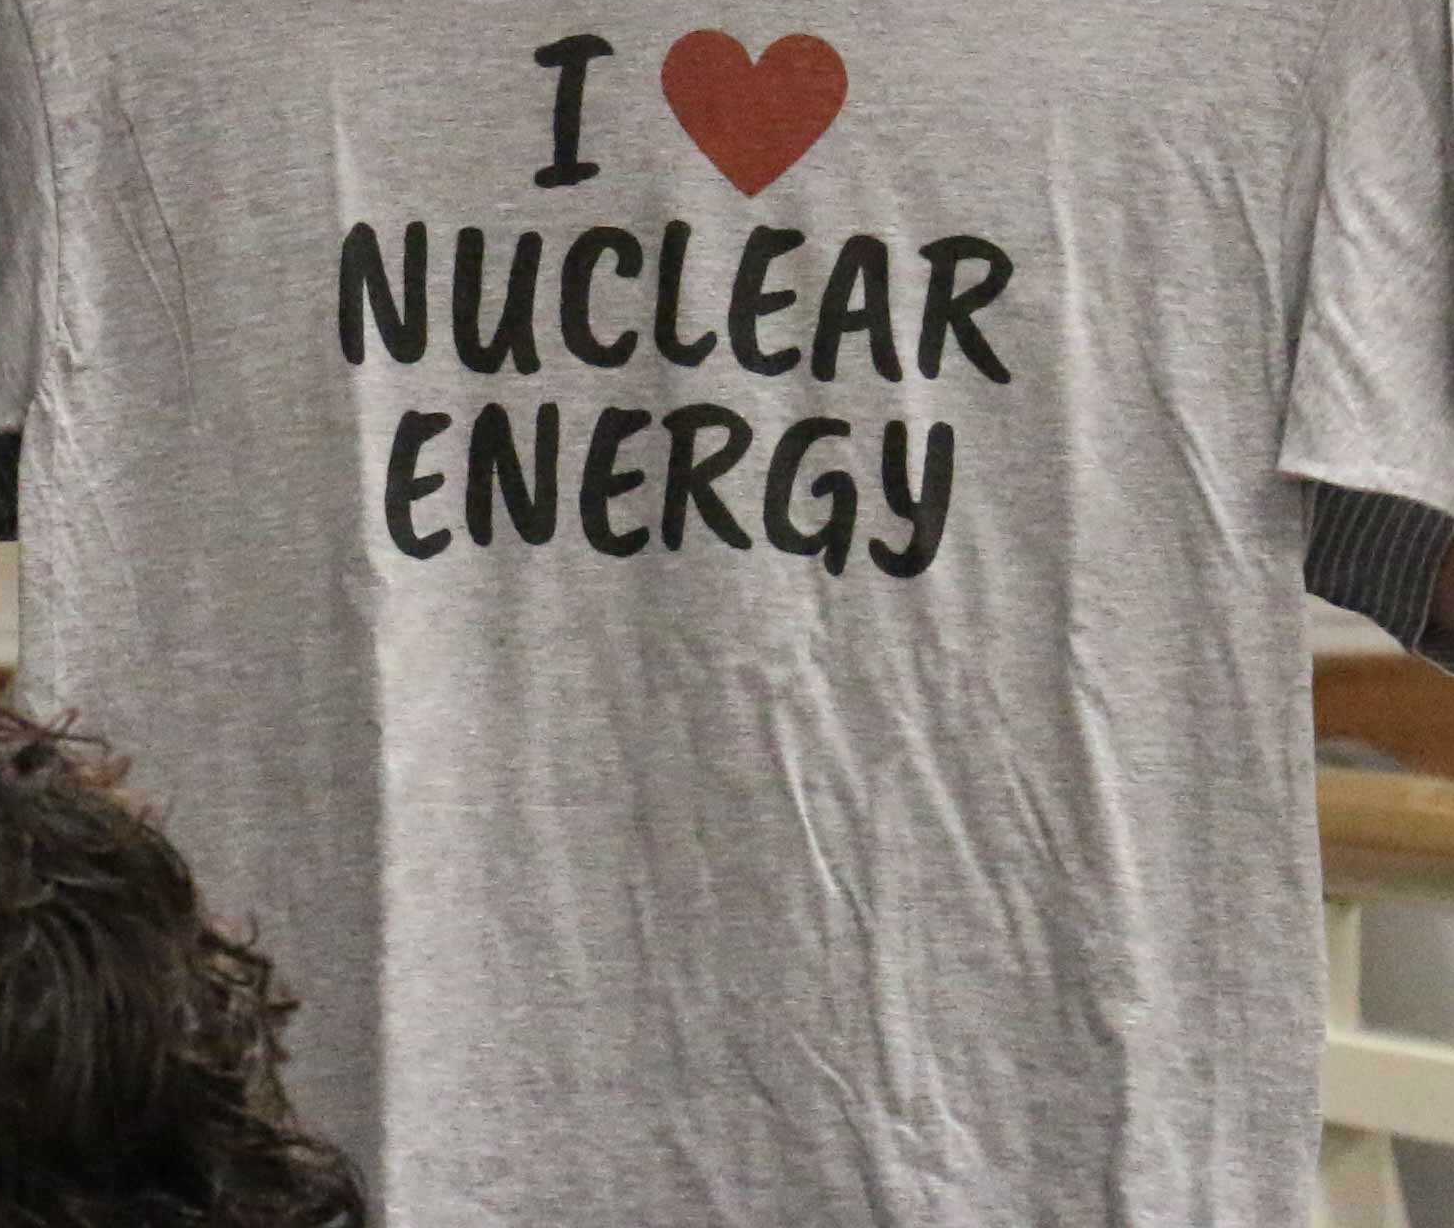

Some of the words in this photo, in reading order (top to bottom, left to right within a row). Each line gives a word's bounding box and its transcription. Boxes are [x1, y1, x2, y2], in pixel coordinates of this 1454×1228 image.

[535, 34, 612, 188] I
[338, 222, 1012, 384] NUCLEAR
[387, 403, 953, 579] ENERGY
